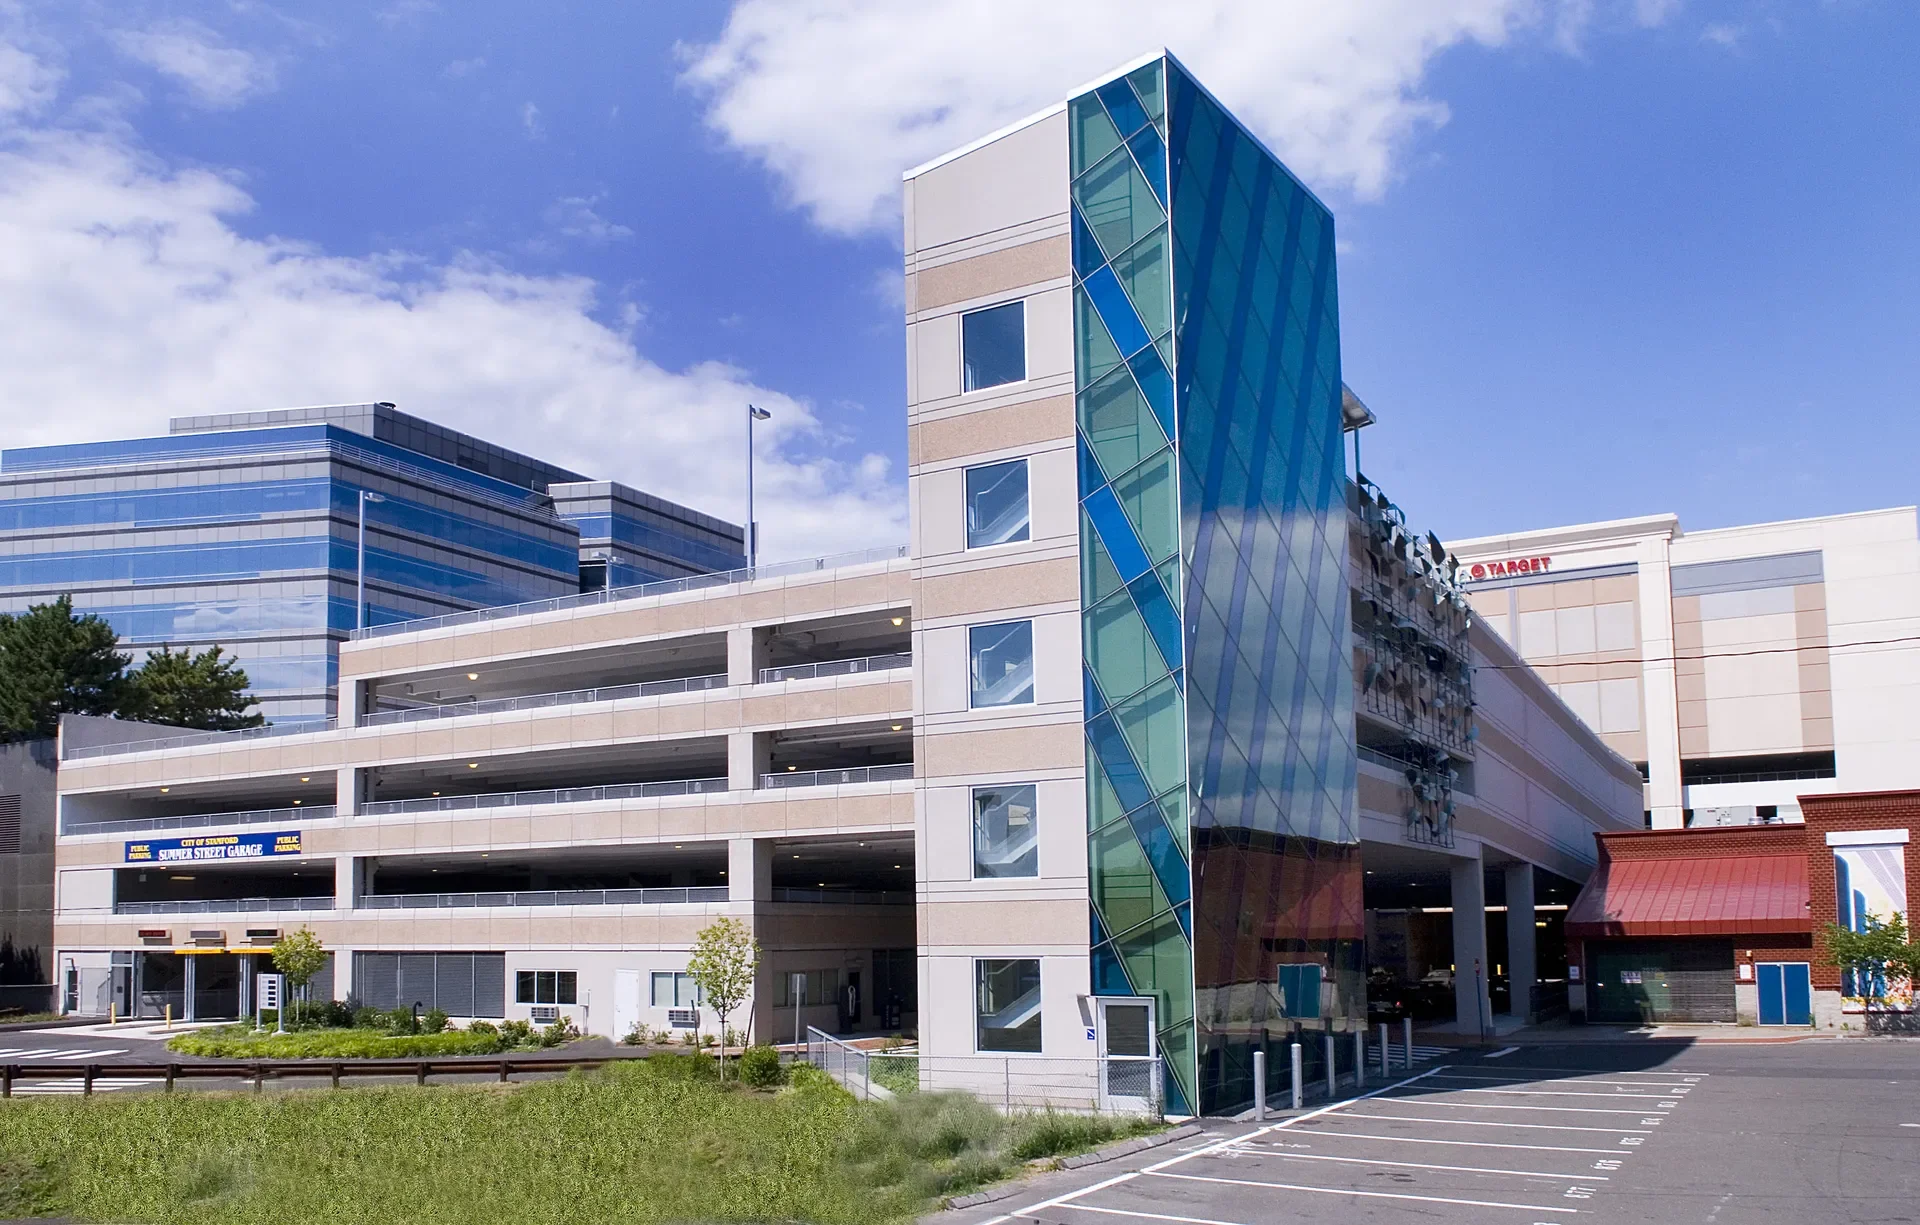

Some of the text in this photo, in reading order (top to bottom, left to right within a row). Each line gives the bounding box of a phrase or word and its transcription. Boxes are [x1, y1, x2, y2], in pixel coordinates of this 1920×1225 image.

[1487, 557, 1550, 575] TARGET
[206, 837, 238, 845] STAMFORD
[277, 836, 299, 844] PUBLIC
[159, 844, 263, 860] SUMMER STREET GARAGE
[274, 844, 301, 852] PARKING
